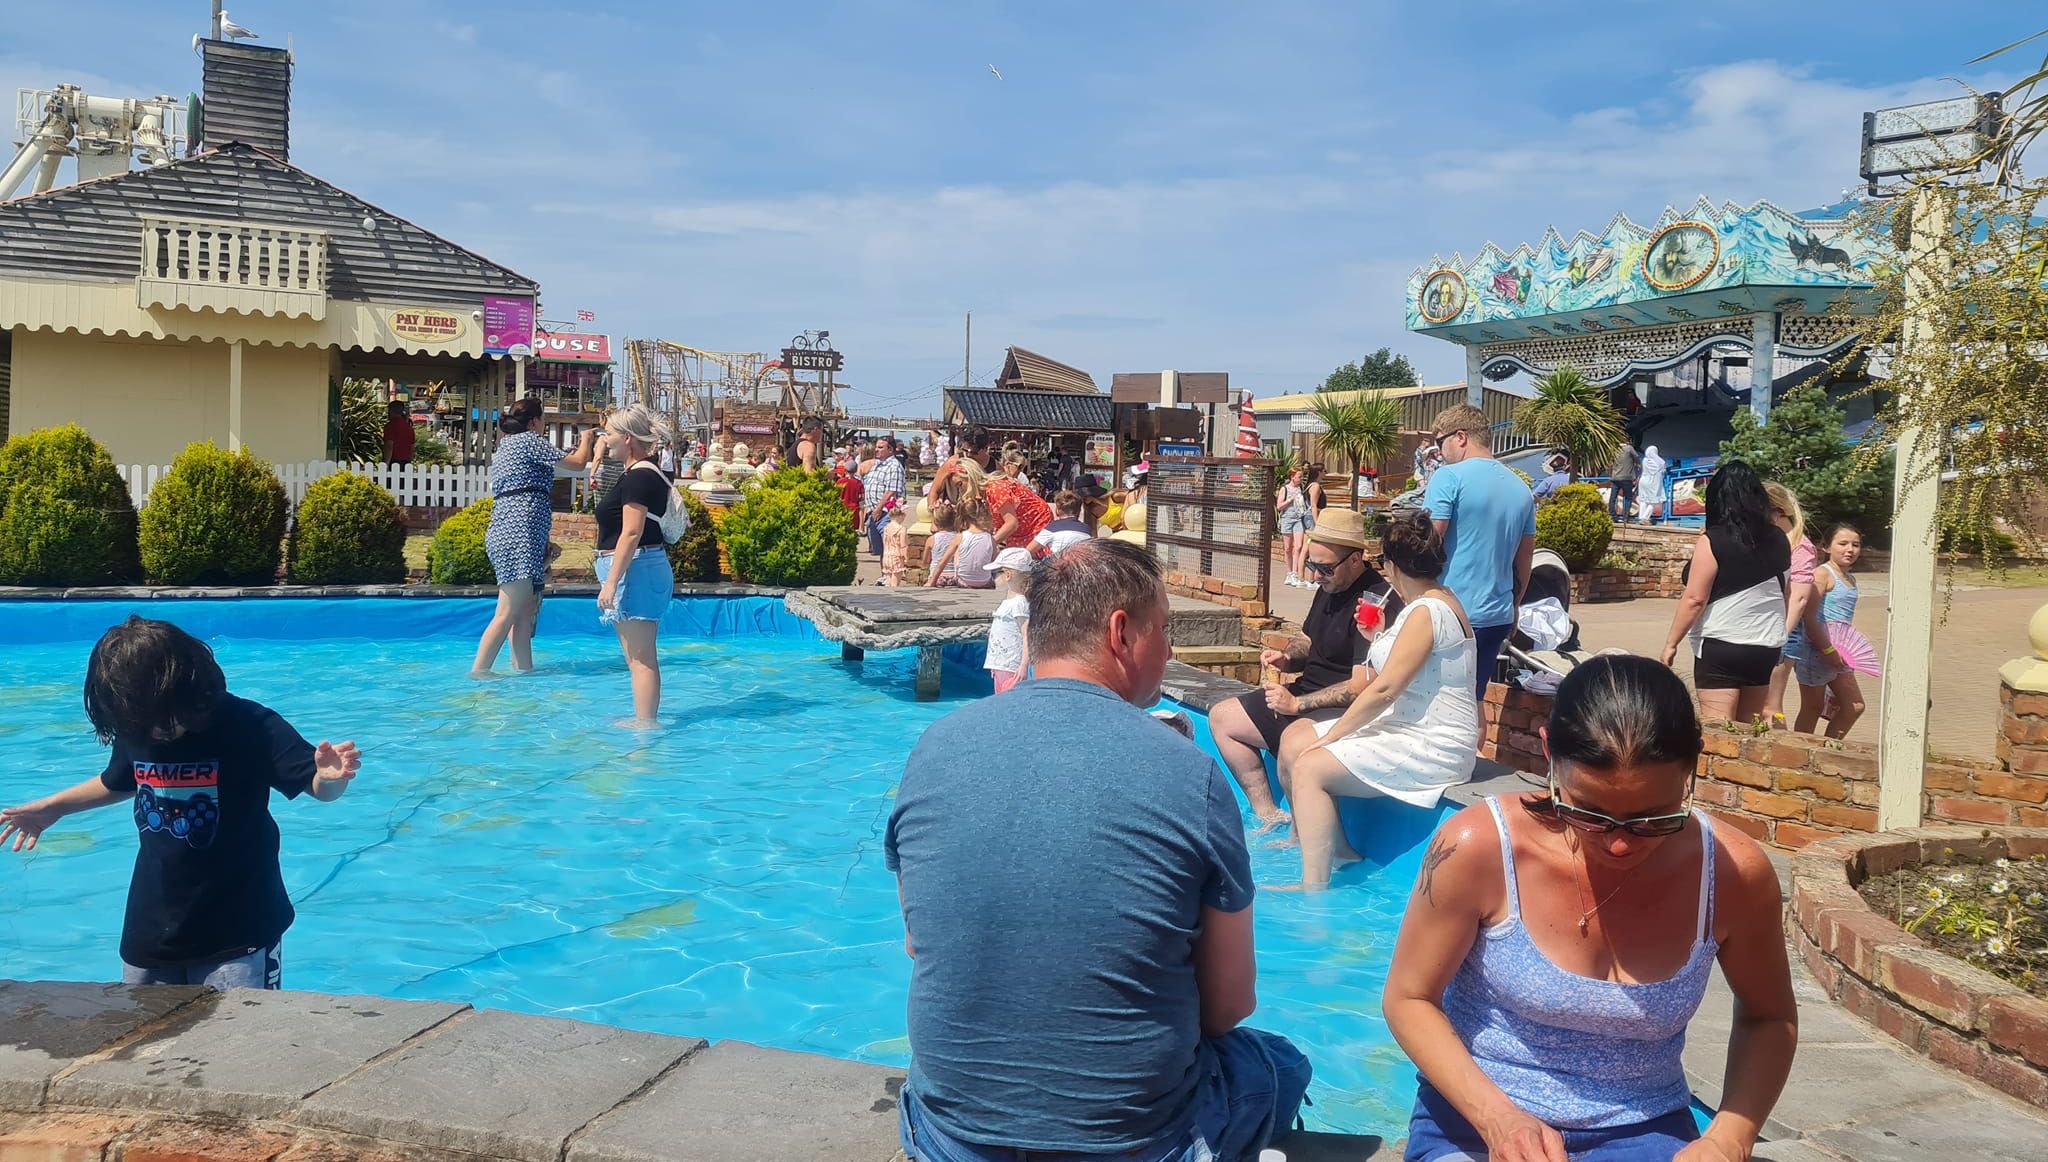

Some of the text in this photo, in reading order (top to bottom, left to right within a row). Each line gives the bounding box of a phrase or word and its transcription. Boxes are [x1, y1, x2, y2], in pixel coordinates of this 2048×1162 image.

[396, 313, 457, 328] PAY HERE
[791, 355, 832, 367] BISTRO
[136, 763, 213, 780] GAMER
